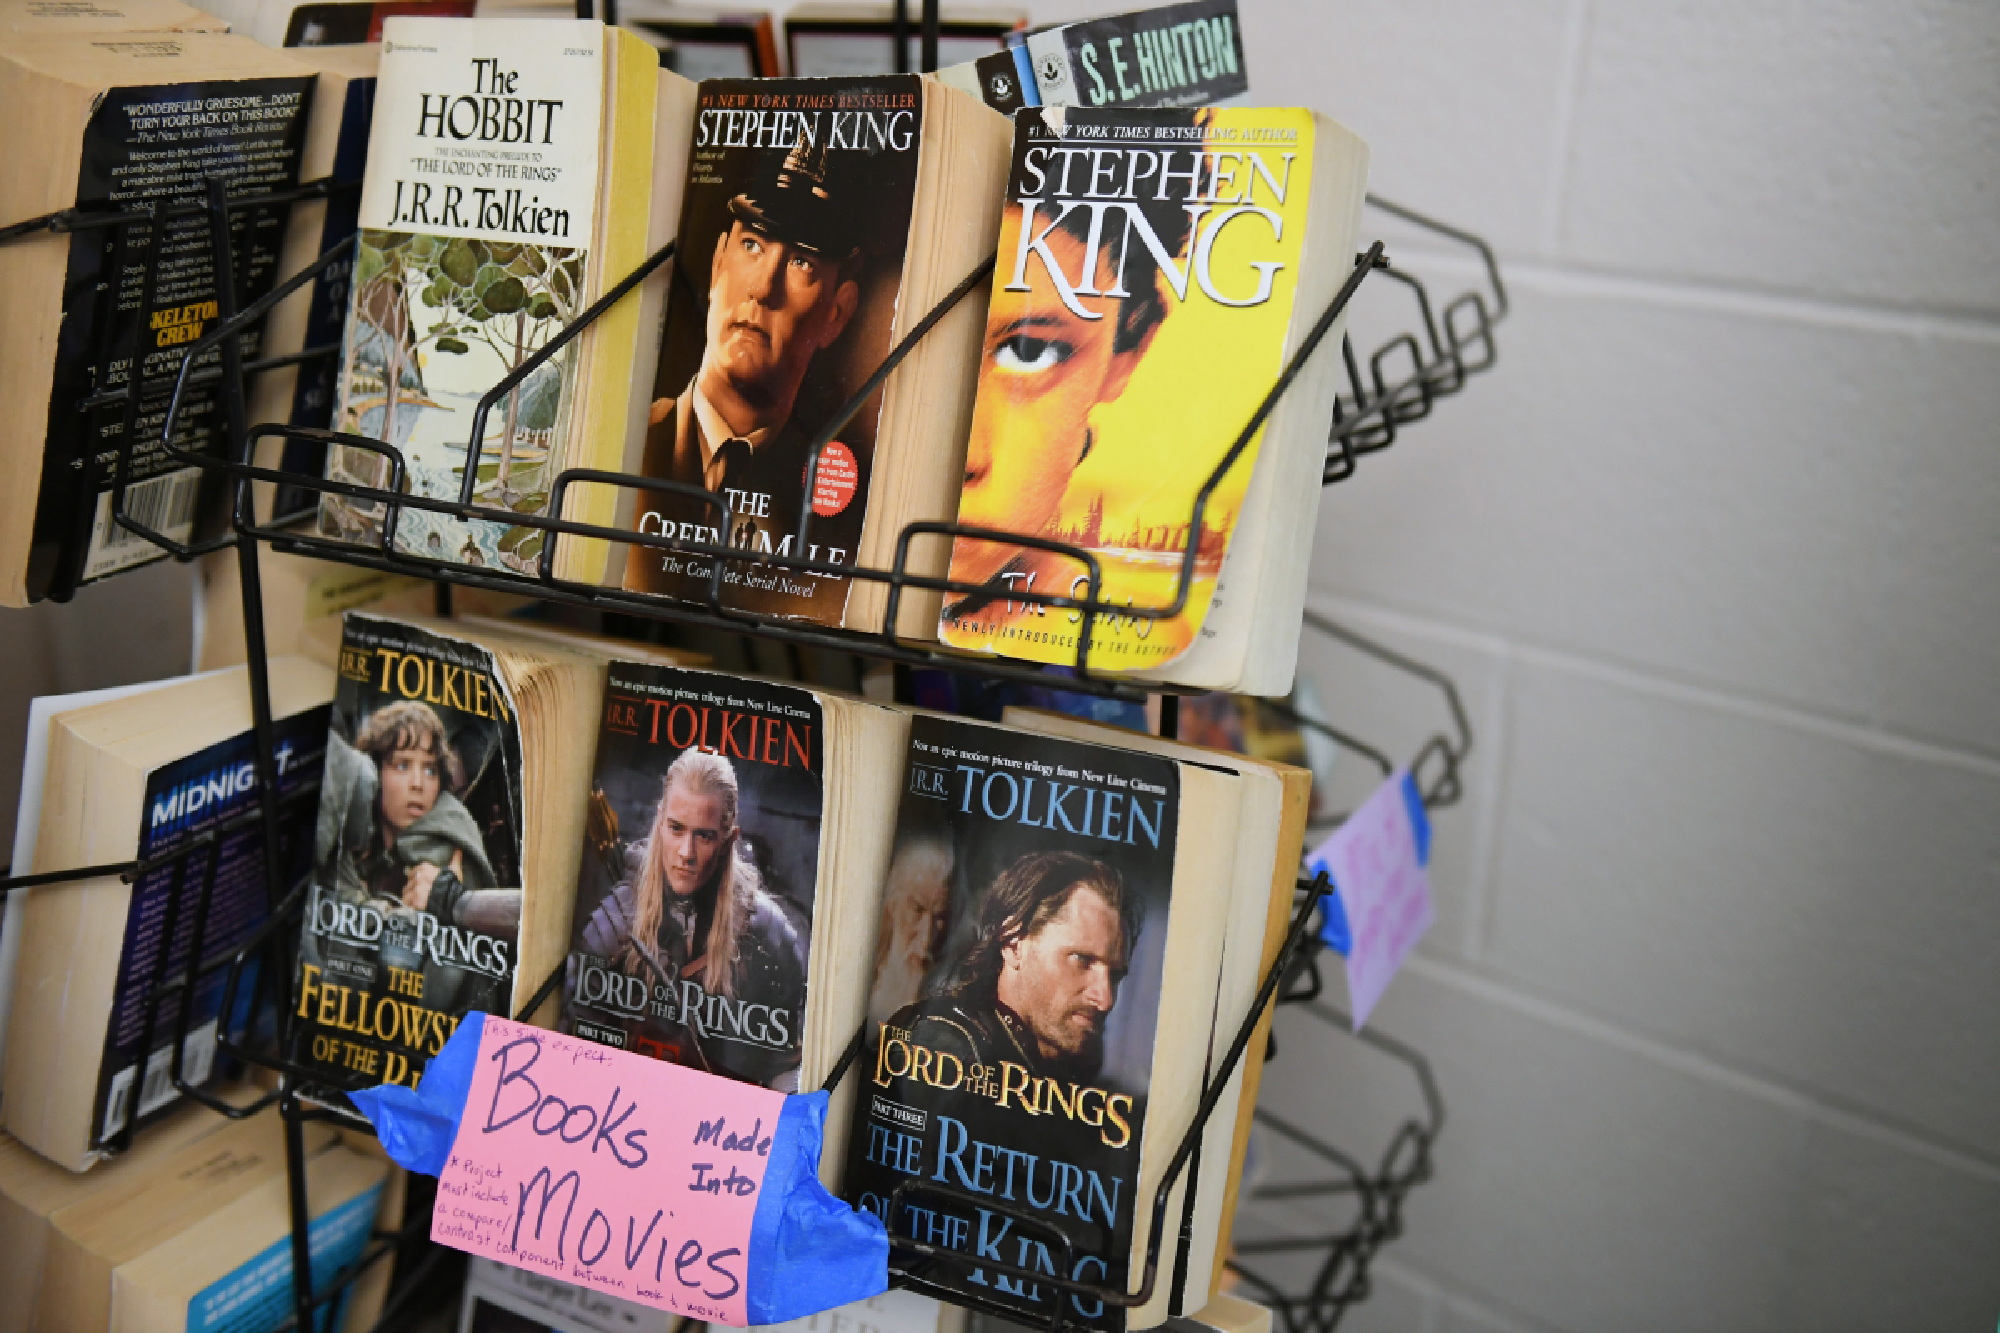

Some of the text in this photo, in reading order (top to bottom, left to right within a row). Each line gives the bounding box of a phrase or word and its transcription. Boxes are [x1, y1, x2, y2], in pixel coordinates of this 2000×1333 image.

[471, 57, 519, 95] The
[1132, 16, 1239, 94] HINTON
[130, 116, 160, 130] TURN
[162, 114, 191, 128] YOUR
[192, 112, 220, 125] BACK
[222, 110, 238, 124] ON
[241, 108, 263, 121] THIS
[415, 92, 563, 145] HOBBIT
[702, 94, 916, 108] #1 NEW YORK TIMES BESTSELLER
[203, 126, 228, 138] Times
[696, 109, 913, 151] STEPHEN KING
[1044, 125, 1072, 138] NW
[1075, 125, 1109, 138] YORK
[1113, 126, 1152, 139] TIMES
[1154, 126, 1237, 140] BESTSELLING
[1242, 127, 1298, 141] AUTHOR
[434, 147, 450, 158] THE
[451, 148, 498, 160] ENCHANTING
[532, 151, 542, 163] TO
[442, 159, 475, 176] LORD
[476, 160, 494, 178] OF
[495, 162, 519, 179] THE
[1018, 146, 1295, 206] STEPHEN
[387, 179, 569, 237] J.R.R. Tolkien
[1004, 198, 1286, 320] KING
[150, 299, 219, 331] KELETO
[157, 321, 203, 348] CREW
[725, 487, 772, 518] THE
[758, 529, 848, 581] MLE
[662, 556, 816, 598] The Comlete Serial Novel
[953, 617, 995, 635] NEWLY
[377, 648, 510, 724] TOLKIEN
[646, 697, 812, 771] TOLKIEN
[152, 747, 293, 829] MIDNIGT
[912, 739, 928, 751] Now
[941, 746, 957, 759] epic
[960, 750, 990, 763] motion
[992, 754, 1022, 769] picture
[1024, 759, 1054, 777] trilogy
[1057, 764, 1079, 779] from
[1082, 769, 1105, 783] New
[1107, 773, 1128, 788] Line
[1130, 777, 1167, 796] Cinema
[956, 764, 1167, 850] TOLKIEN
[309, 885, 384, 942] LORD
[389, 915, 409, 931] OF
[412, 911, 509, 976] RINGS
[387, 966, 425, 999] THE
[573, 952, 648, 1012] LORD
[655, 984, 675, 1001] OF
[650, 1002, 676, 1021] THE
[678, 980, 790, 1047] RINGS
[312, 1035, 341, 1063] OF
[343, 1041, 379, 1076] THE
[482, 1037, 648, 1169] Books
[872, 1020, 1133, 1149] THE LORD OF THE RINGS
[874, 1099, 924, 1127] PART THREE
[693, 1116, 772, 1157] Made
[688, 1162, 757, 1197] Into
[866, 1115, 1124, 1230] THE RETURN
[511, 1166, 742, 1300] Movies
